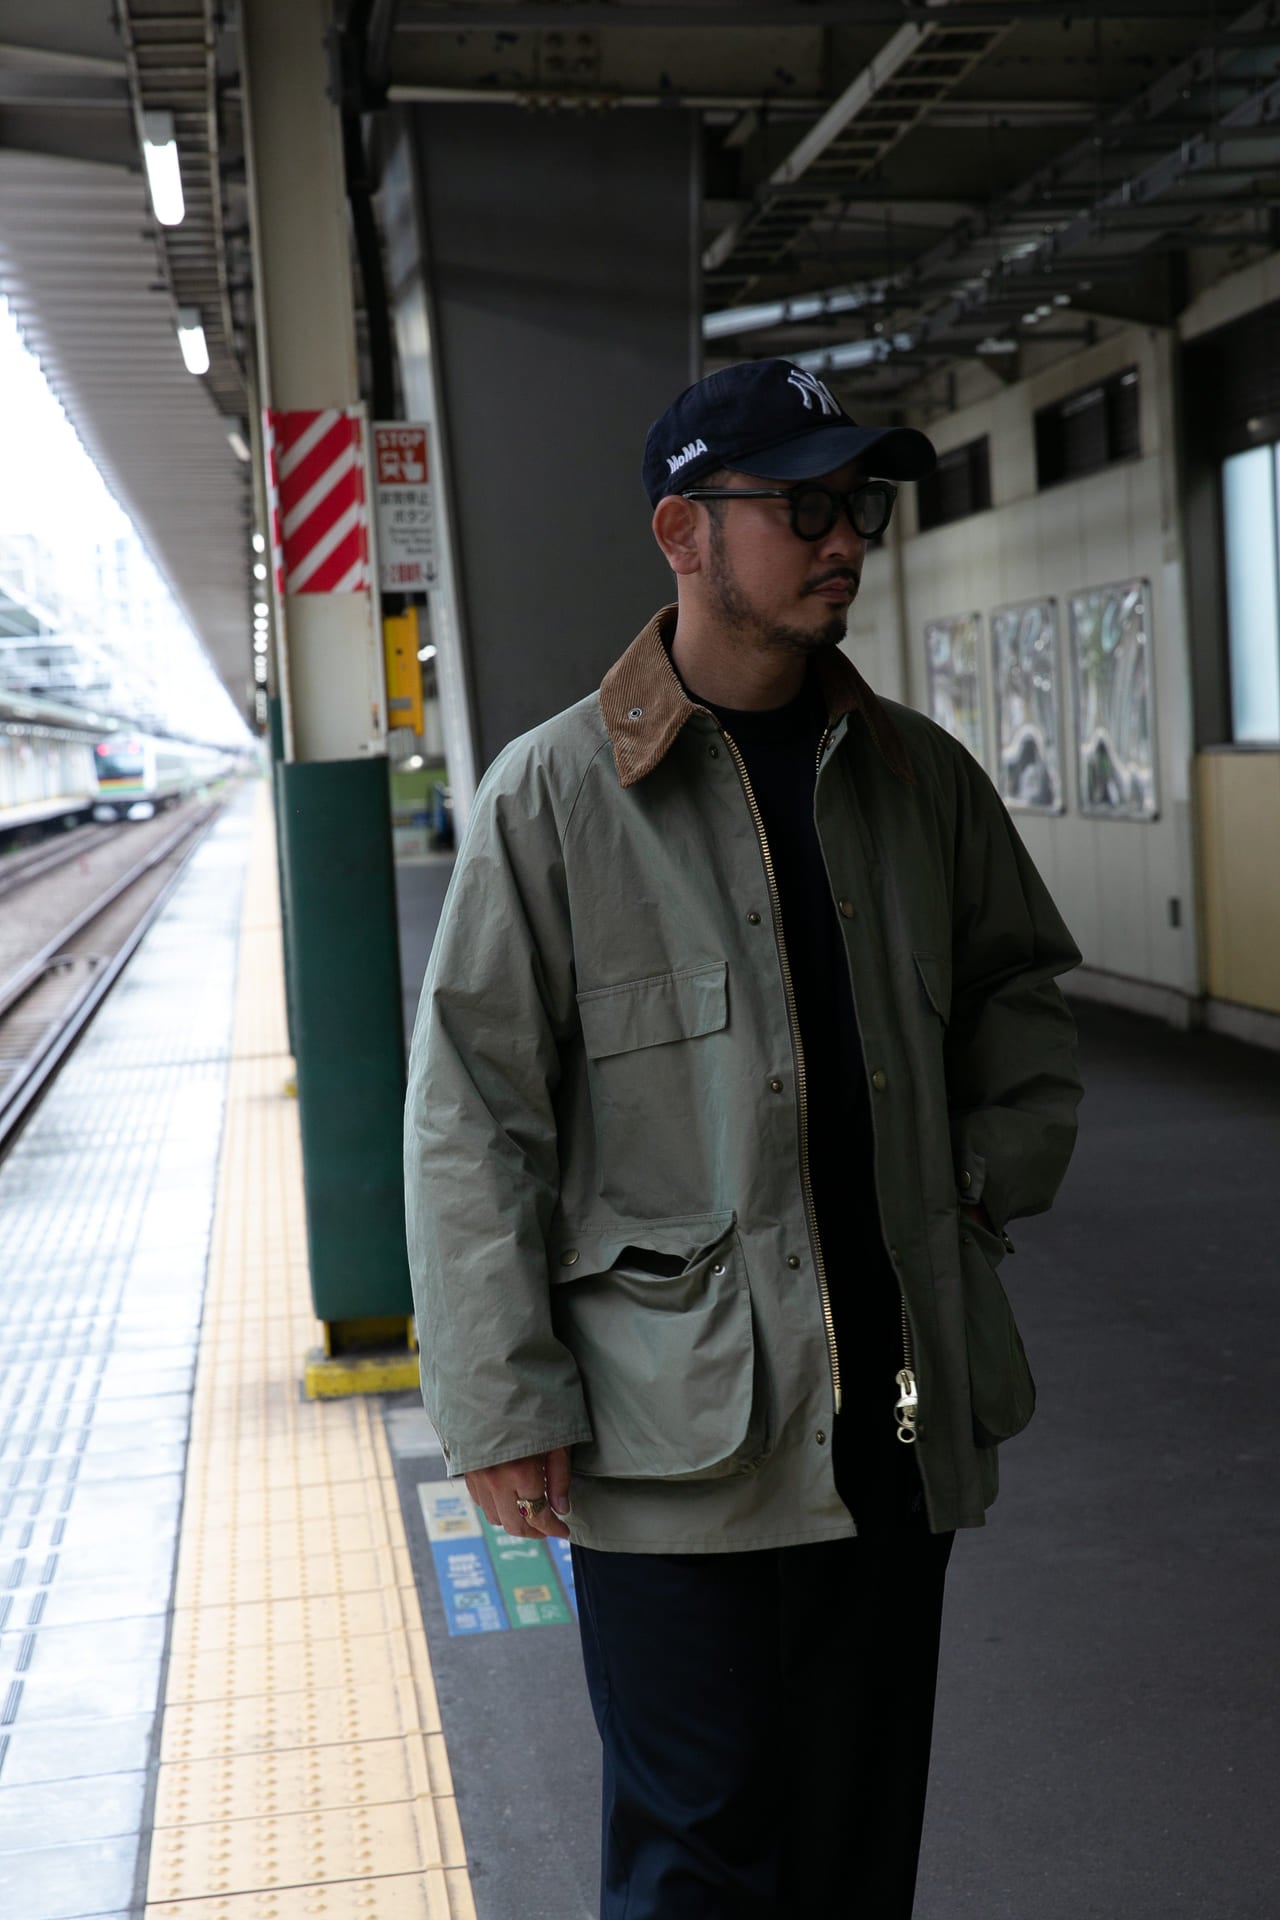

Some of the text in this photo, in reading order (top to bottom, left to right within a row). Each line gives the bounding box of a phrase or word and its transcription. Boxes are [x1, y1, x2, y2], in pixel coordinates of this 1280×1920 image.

[787, 369, 842, 416] NY
[377, 431, 423, 448] STOP
[666, 438, 708, 474] MoMA
